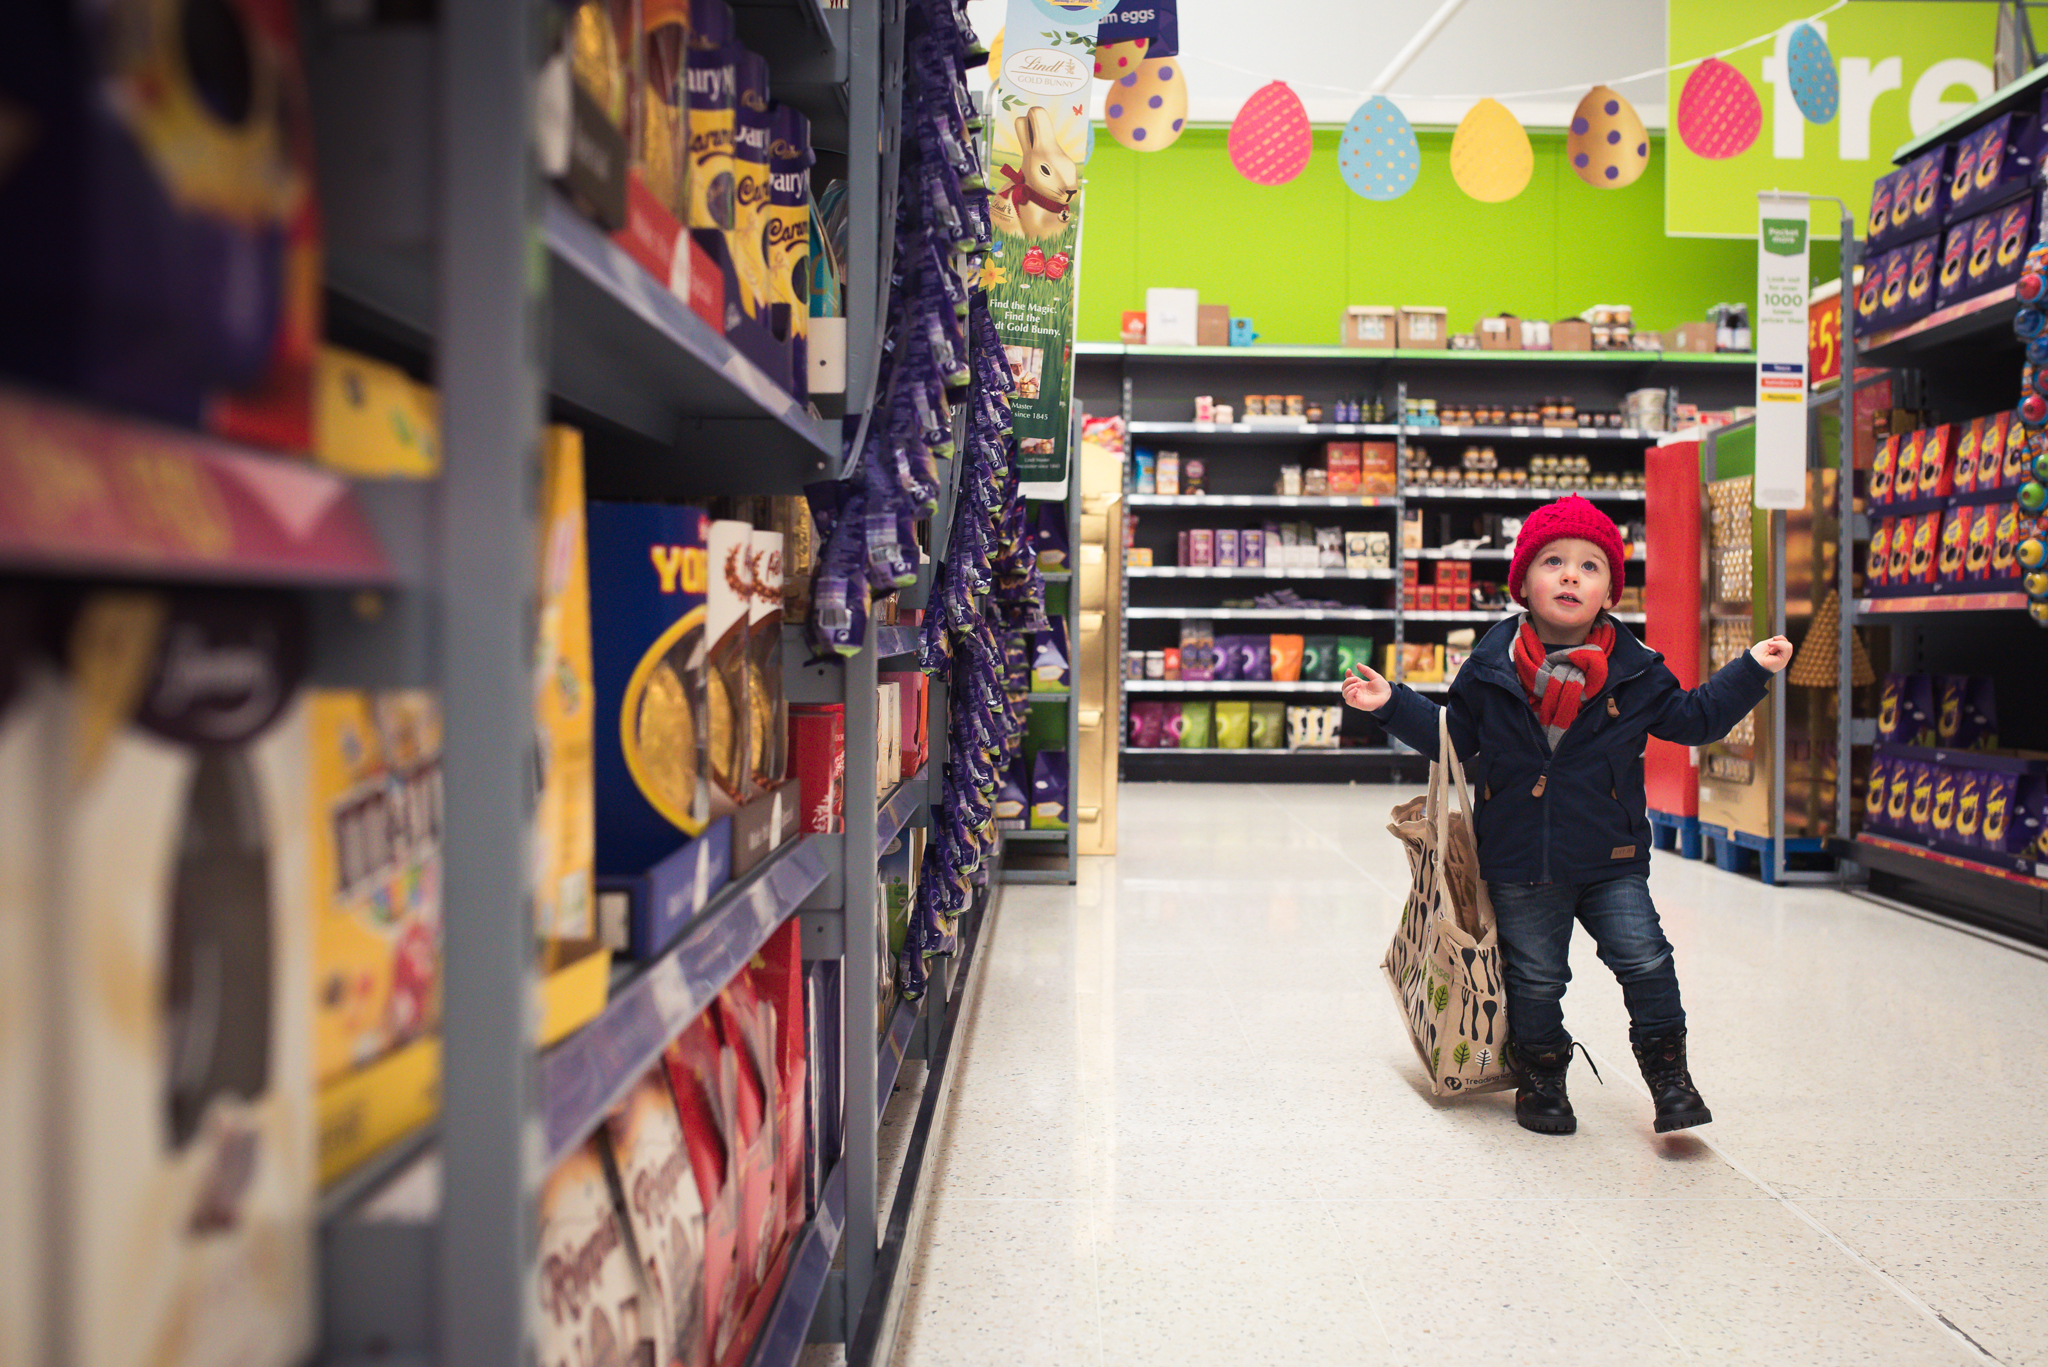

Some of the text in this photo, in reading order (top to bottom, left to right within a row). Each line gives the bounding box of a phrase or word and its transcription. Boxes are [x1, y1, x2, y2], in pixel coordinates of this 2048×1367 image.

[1121, 9, 1155, 25] eggs
[1020, 55, 1065, 73] Lindt
[1018, 75, 1075, 88] GOLD BUNNY
[989, 298, 1058, 315] Find the Magic.
[1764, 292, 1803, 307] 1000
[1004, 311, 1041, 323] Find the
[1007, 322, 1029, 333] Gold
[1031, 324, 1061, 338] Bunny.
[1011, 402, 1033, 410] Master
[1014, 411, 1048, 420] since 1845
